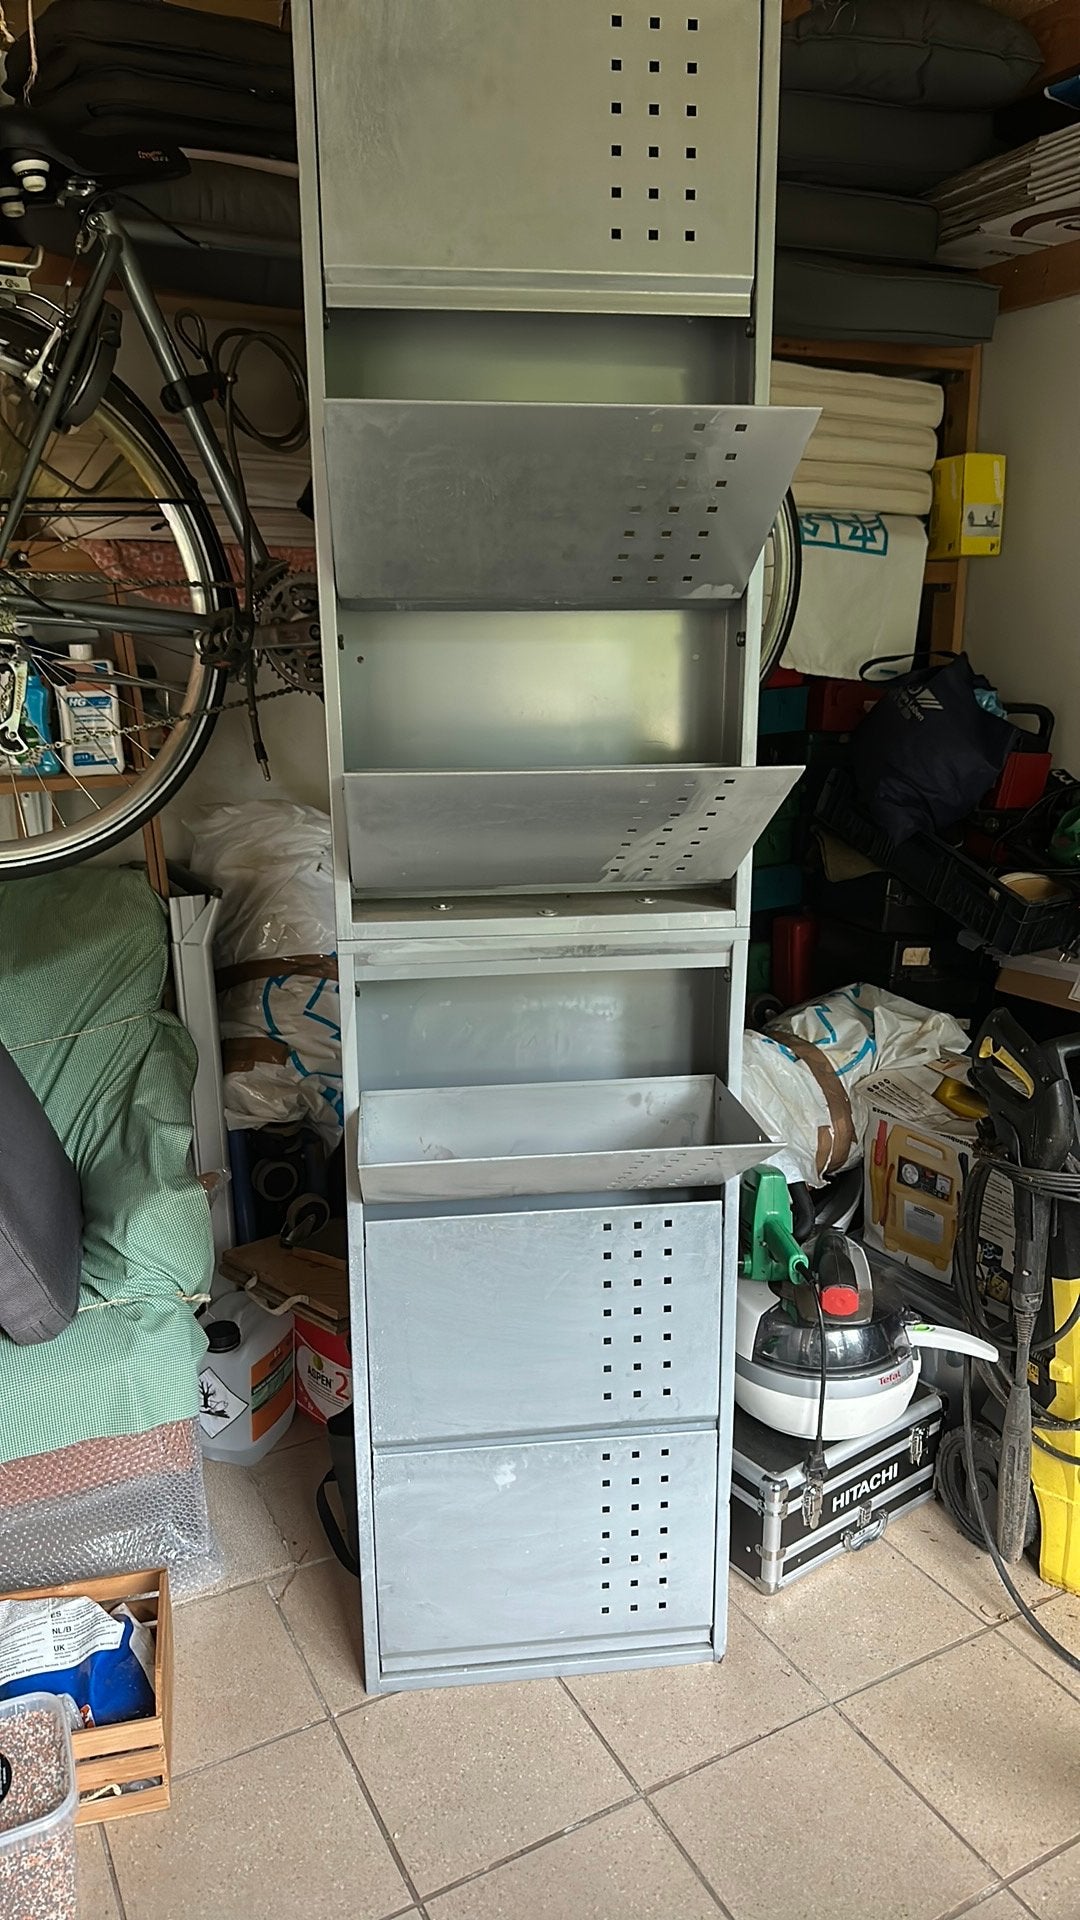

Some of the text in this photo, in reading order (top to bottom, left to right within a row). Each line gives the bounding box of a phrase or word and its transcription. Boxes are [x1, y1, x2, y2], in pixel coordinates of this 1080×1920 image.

[69, 698, 87, 707] HG
[307, 1365, 332, 1389] ASPEN
[335, 1371, 350, 1401] 2
[879, 1371, 901, 1386] Tefal
[832, 1462, 899, 1513] HITACHI
